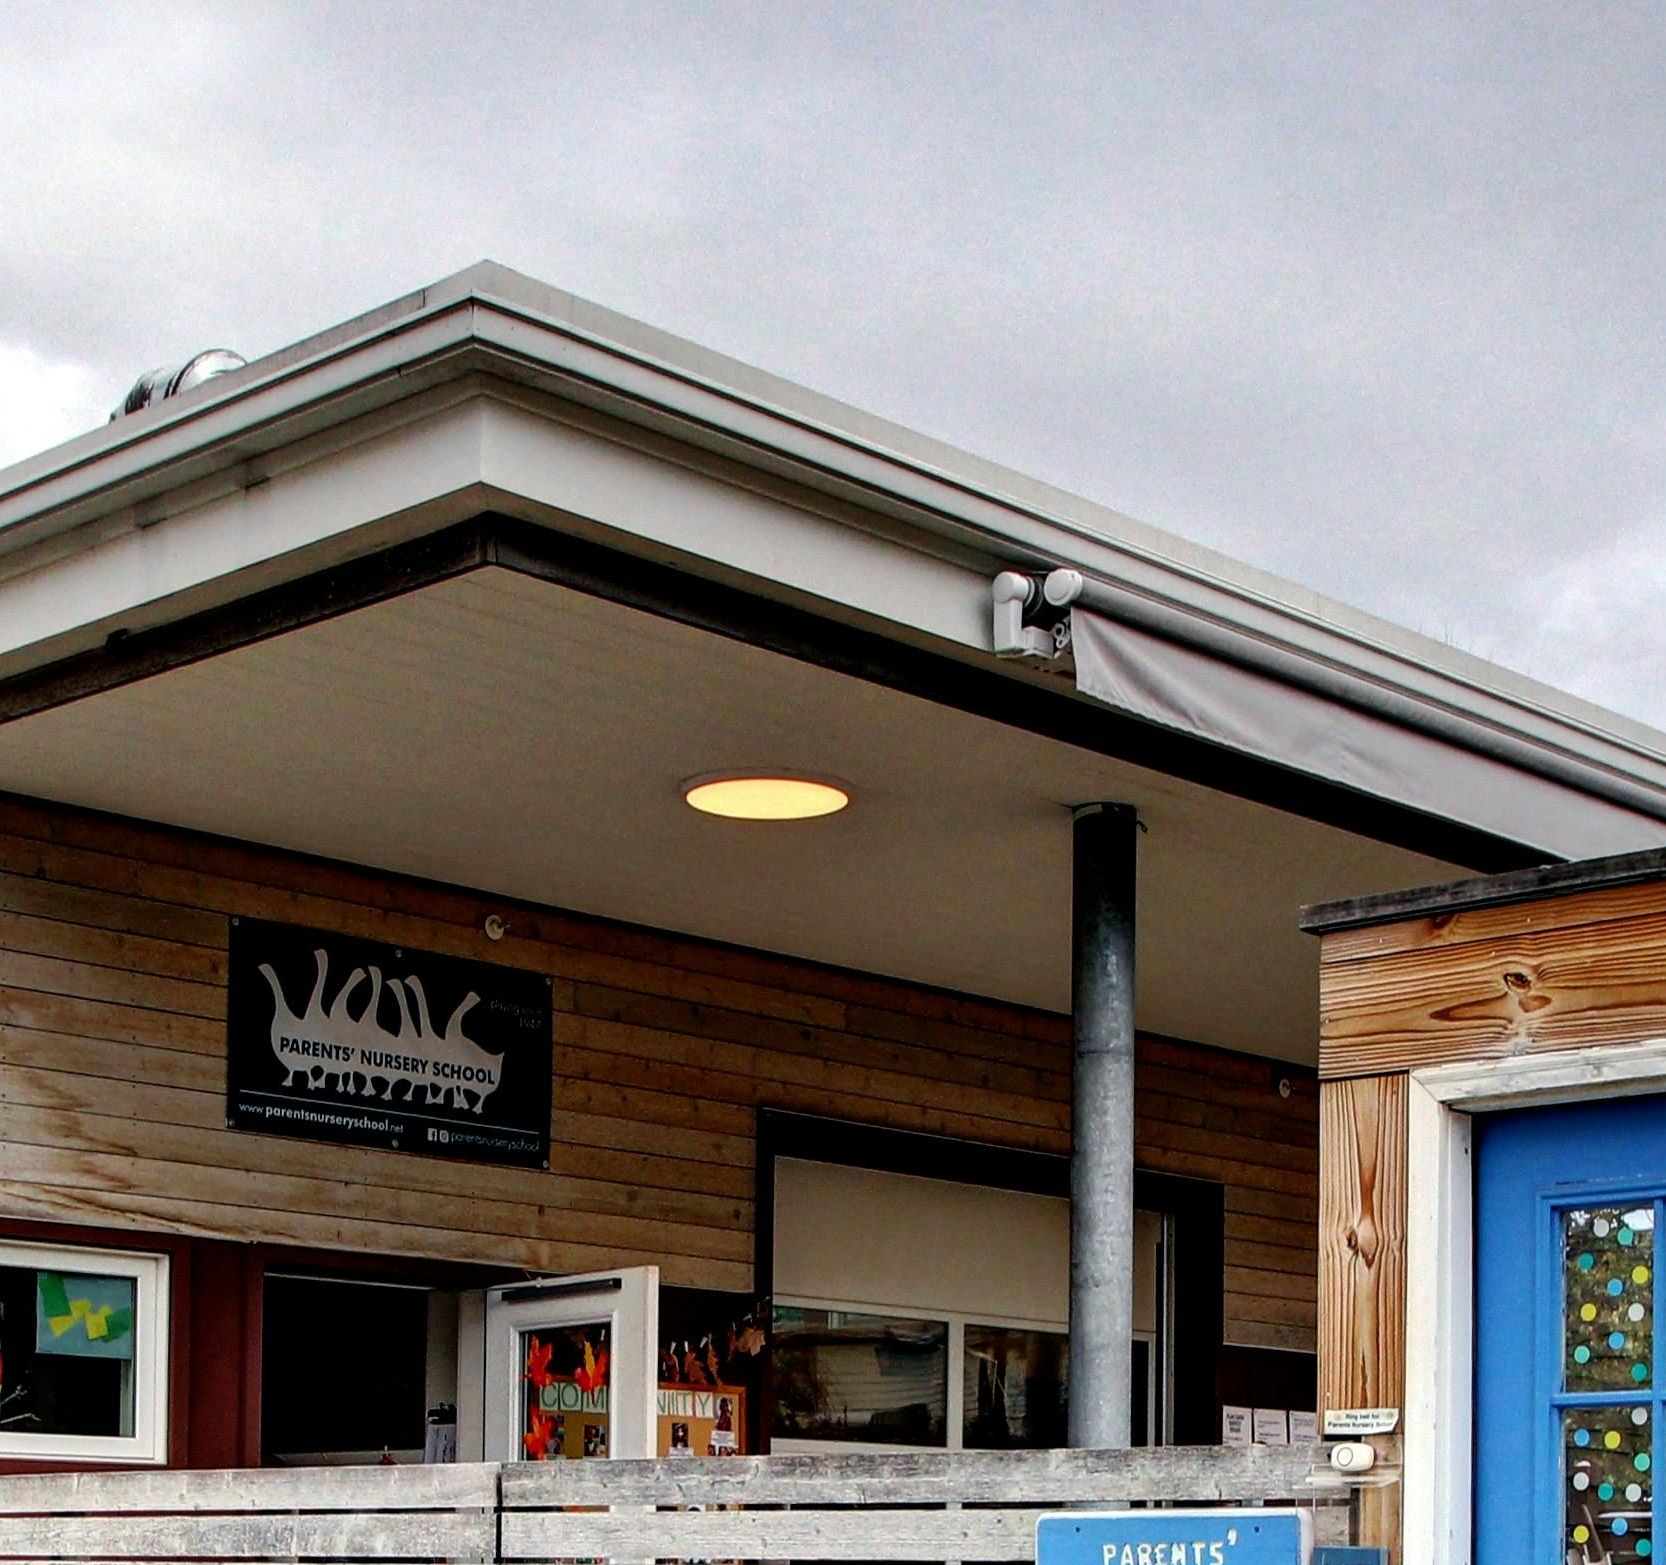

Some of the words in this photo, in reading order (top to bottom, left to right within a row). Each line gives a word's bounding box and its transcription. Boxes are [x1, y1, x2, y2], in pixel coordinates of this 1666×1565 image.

[279, 1035, 355, 1063] PARENTS'
[360, 1049, 429, 1076] NURSERY
[432, 1060, 496, 1086] SCHOOL
